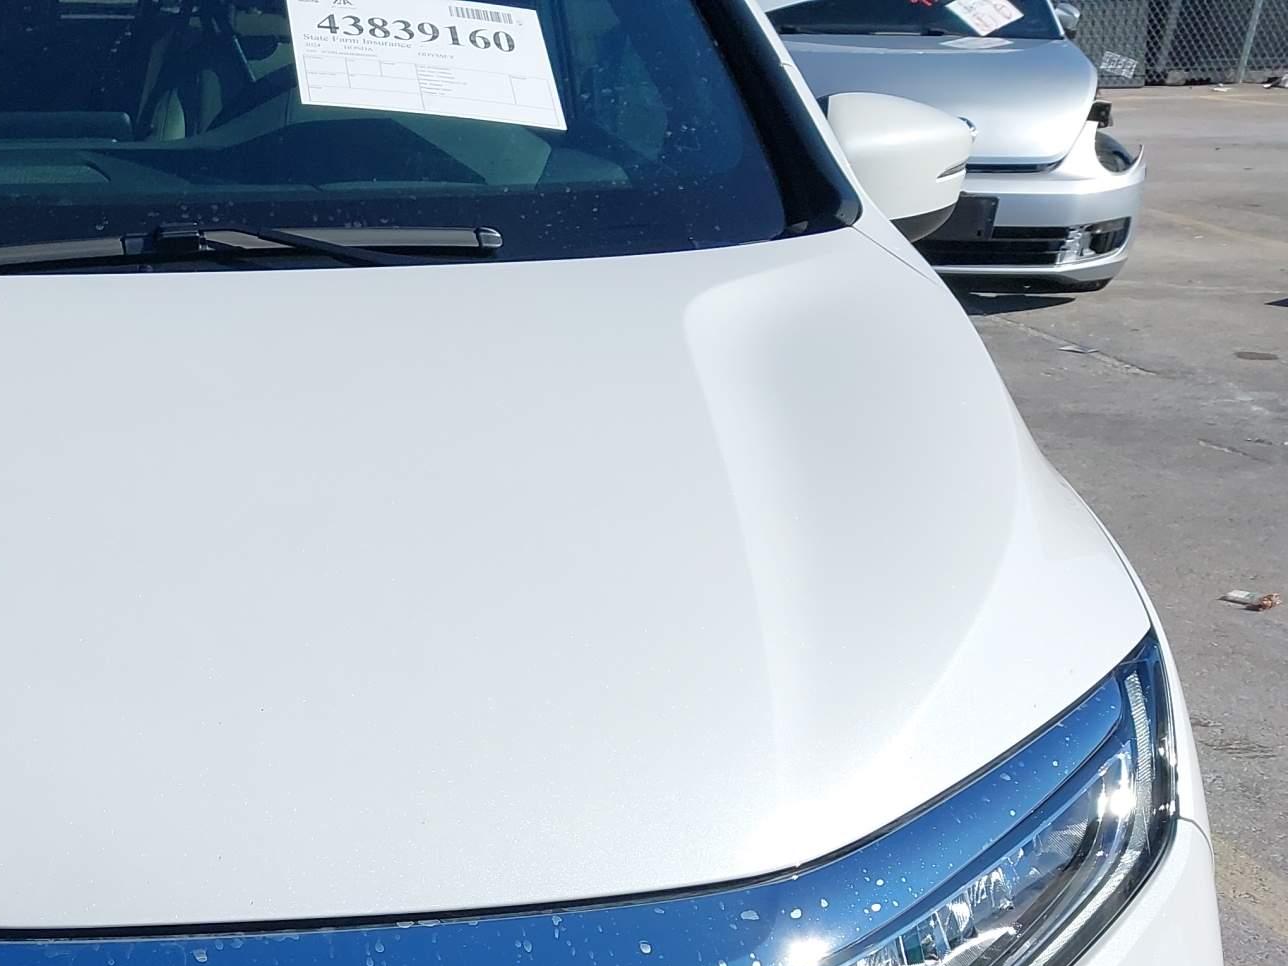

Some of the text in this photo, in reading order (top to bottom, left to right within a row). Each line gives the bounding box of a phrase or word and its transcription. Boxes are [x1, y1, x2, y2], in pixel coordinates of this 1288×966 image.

[303, 33, 412, 49] State Farm Insurance
[317, 13, 515, 53] 43839160
